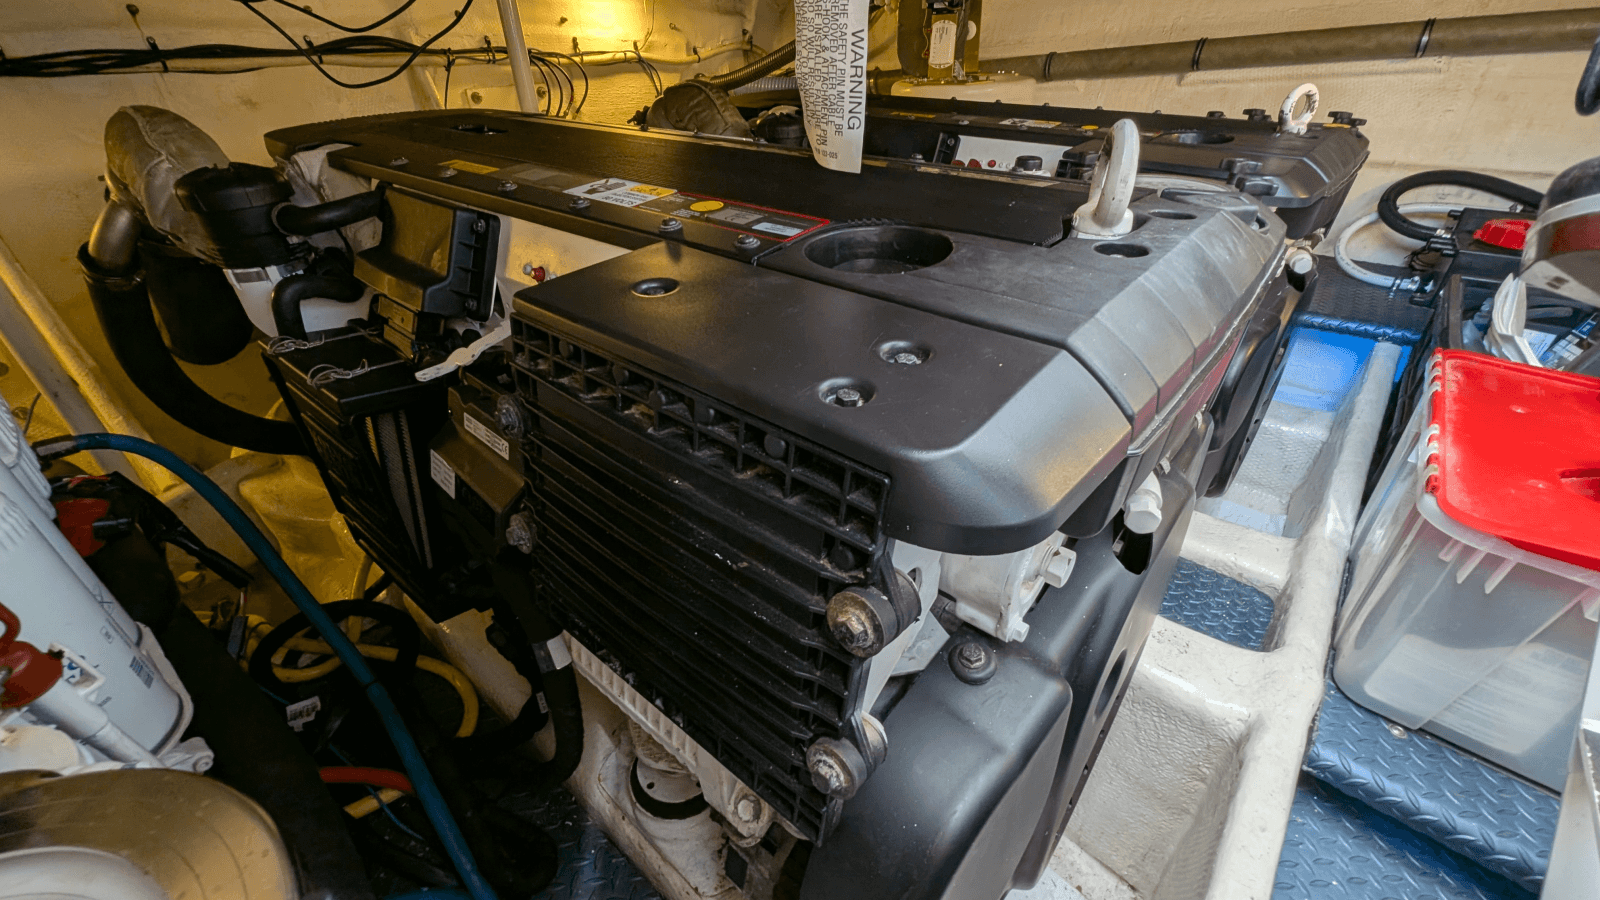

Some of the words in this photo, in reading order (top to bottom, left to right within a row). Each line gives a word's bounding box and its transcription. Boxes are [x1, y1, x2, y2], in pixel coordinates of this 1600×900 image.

[808, 17, 815, 32] SO
[830, 0, 839, 52] REMOVED
[822, 45, 830, 53] &
[838, 23, 848, 65] SAFETY
[802, 54, 808, 68] TO
[829, 56, 838, 90] AFTER
[821, 57, 830, 126] ATTACHMENT
[837, 69, 846, 86] PIN
[847, 29, 864, 130] WARNING
[814, 89, 822, 129] FAILURE
[828, 94, 836, 126] CABLE
[835, 91, 845, 120] MUST
[816, 134, 822, 146] TO
[834, 124, 844, 136] BE
